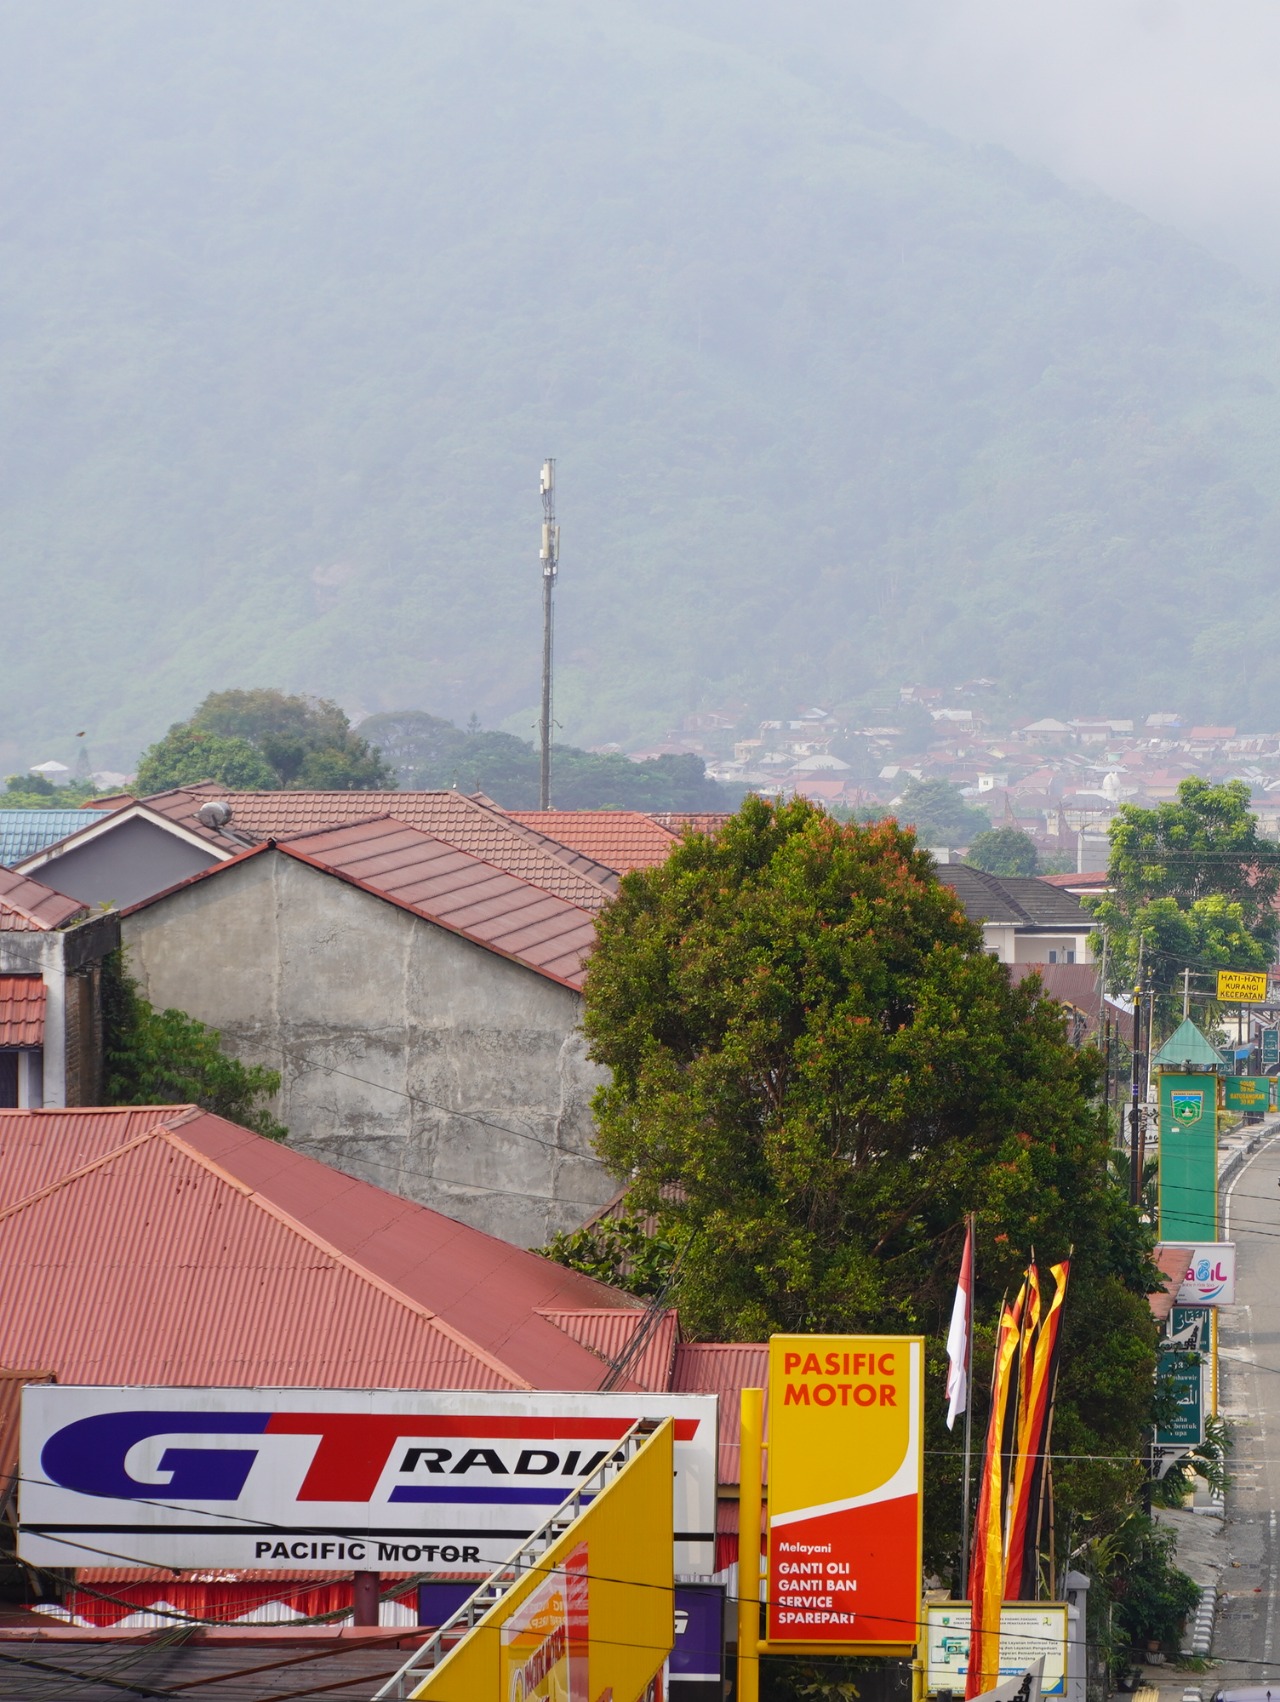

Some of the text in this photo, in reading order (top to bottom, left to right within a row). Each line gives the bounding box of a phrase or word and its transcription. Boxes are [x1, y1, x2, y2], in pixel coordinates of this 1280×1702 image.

[1221, 974, 1264, 983] HATI-HATI
[1225, 982, 1259, 991] KURANGI
[1220, 990, 1263, 1000] KECEPATAN
[785, 1353, 895, 1376] PASIFIC
[784, 1383, 897, 1407] MOTOR
[399, 1448, 677, 1476] RADIA
[255, 1541, 480, 1563] PACIFIC MOTOR
[779, 1542, 831, 1555] Melayani
[778, 1563, 850, 1574] GANTI OLI
[778, 1580, 857, 1591] GANTI BAN
[778, 1596, 833, 1608] SERVICE
[778, 1612, 856, 1624] SPAREPART
